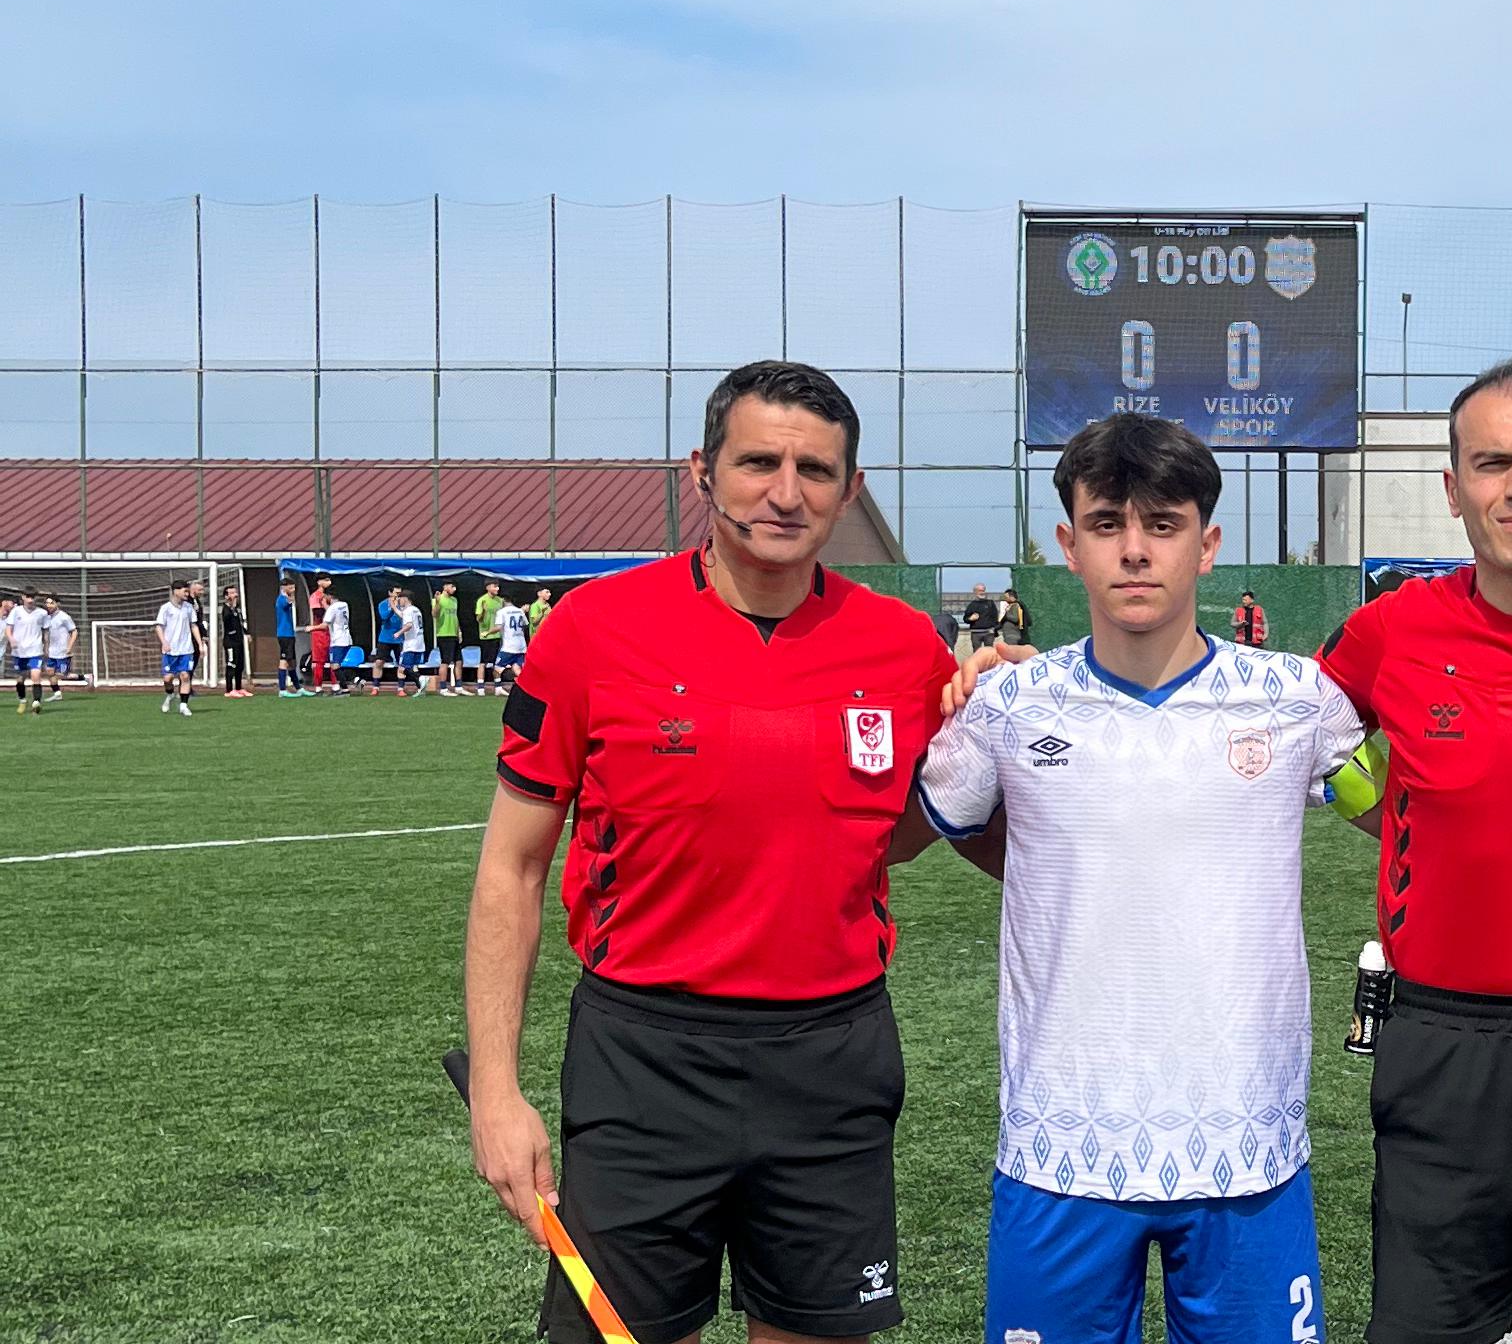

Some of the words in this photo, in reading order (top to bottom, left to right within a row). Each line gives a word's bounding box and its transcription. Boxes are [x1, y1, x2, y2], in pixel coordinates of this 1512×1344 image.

[1130, 245, 1256, 285] 10:00
[1121, 320, 1155, 390] 0
[1227, 320, 1260, 390] 0
[1203, 393, 1294, 415] VELİKÖY
[1217, 419, 1277, 436] SPOR
[859, 753, 887, 767] TFF
[1033, 756, 1069, 767] umbro
[1289, 1274, 1317, 1342] 2
